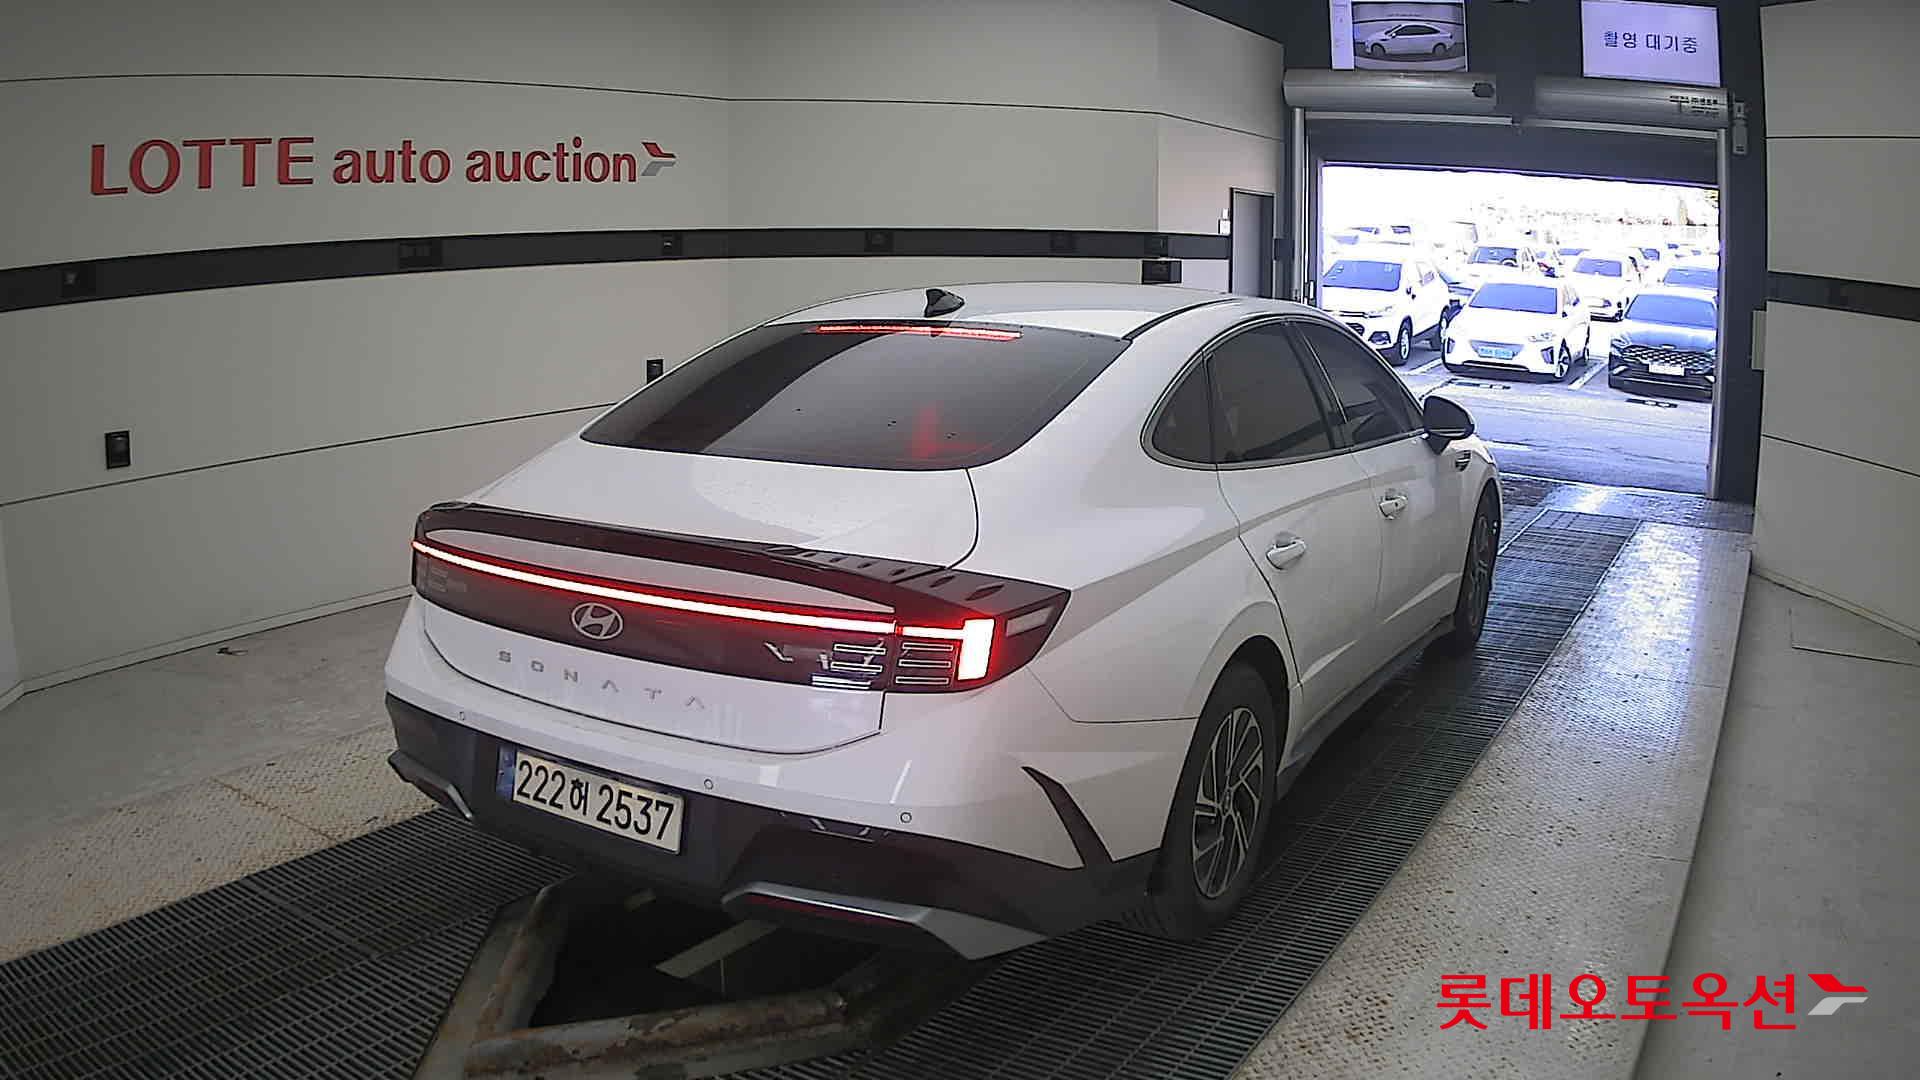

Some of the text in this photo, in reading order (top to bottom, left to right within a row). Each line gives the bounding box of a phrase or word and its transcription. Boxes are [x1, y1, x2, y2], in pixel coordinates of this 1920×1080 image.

[1604, 31, 1697, 54] 촬영 대기중
[90, 136, 637, 196] LOTTE auto auction
[498, 650, 706, 710] SONATA
[516, 759, 675, 841] 222허 2537
